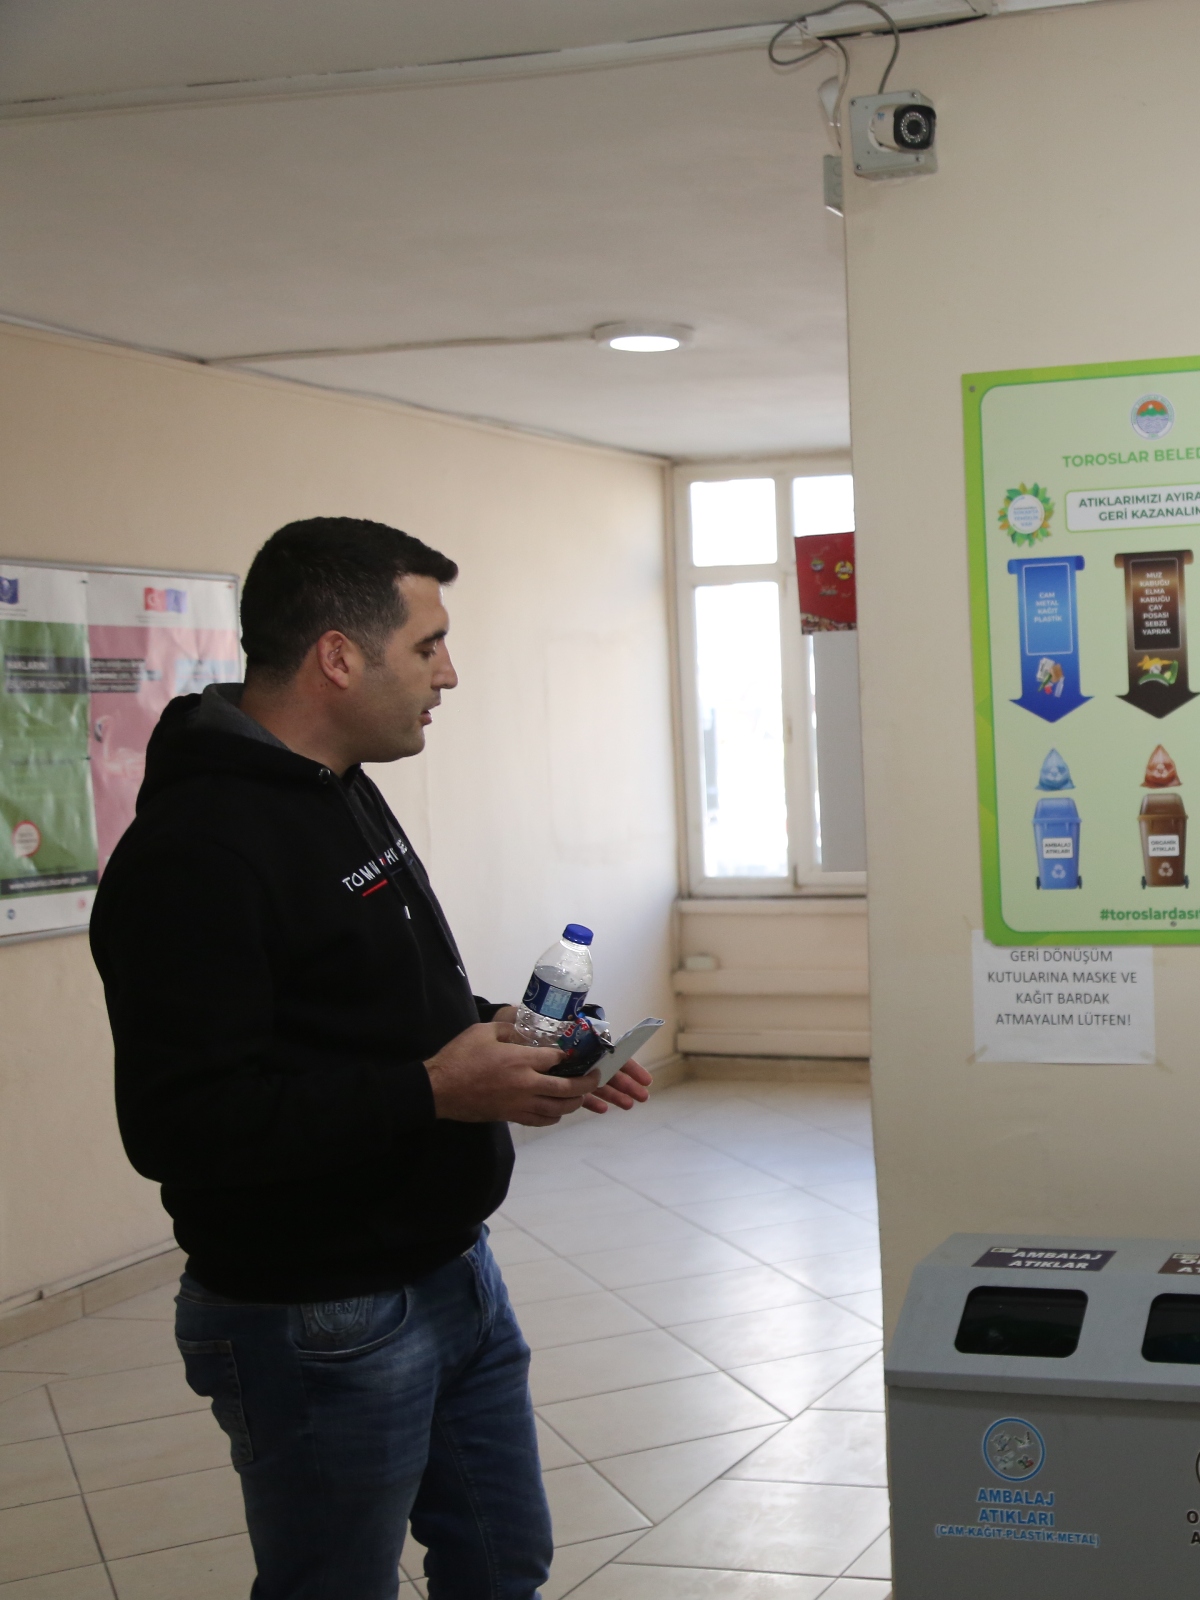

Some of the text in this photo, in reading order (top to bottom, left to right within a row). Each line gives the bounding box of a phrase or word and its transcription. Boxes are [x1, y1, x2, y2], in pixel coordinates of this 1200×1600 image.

[1062, 451, 1149, 468] TOROSLAR
[1078, 494, 1162, 508] ATIKLARIMIZI
[1098, 507, 1128, 521] GERİ
[1146, 571, 1163, 579] MUZ
[1140, 595, 1171, 603] KABUĞU
[1148, 604, 1163, 612] ÇAY
[1010, 948, 1113, 964] GERİ DÖNÜŞÜM
[987, 971, 1138, 983] KUTULARINA MASKE VE
[1016, 990, 1110, 1005] KAĞIT BARDAK
[995, 1011, 1131, 1026] ATMAYALIM LÜTFEN!
[1012, 1250, 1102, 1261] AMBALAJ
[1007, 1260, 1089, 1270] ATIKLAR
[977, 1487, 1055, 1507] AMBALAJ
[978, 1507, 1055, 1527] ATIKLARI
[935, 1524, 1101, 1548] (CAM-KAĞIT-PLASTİK-METAL)
